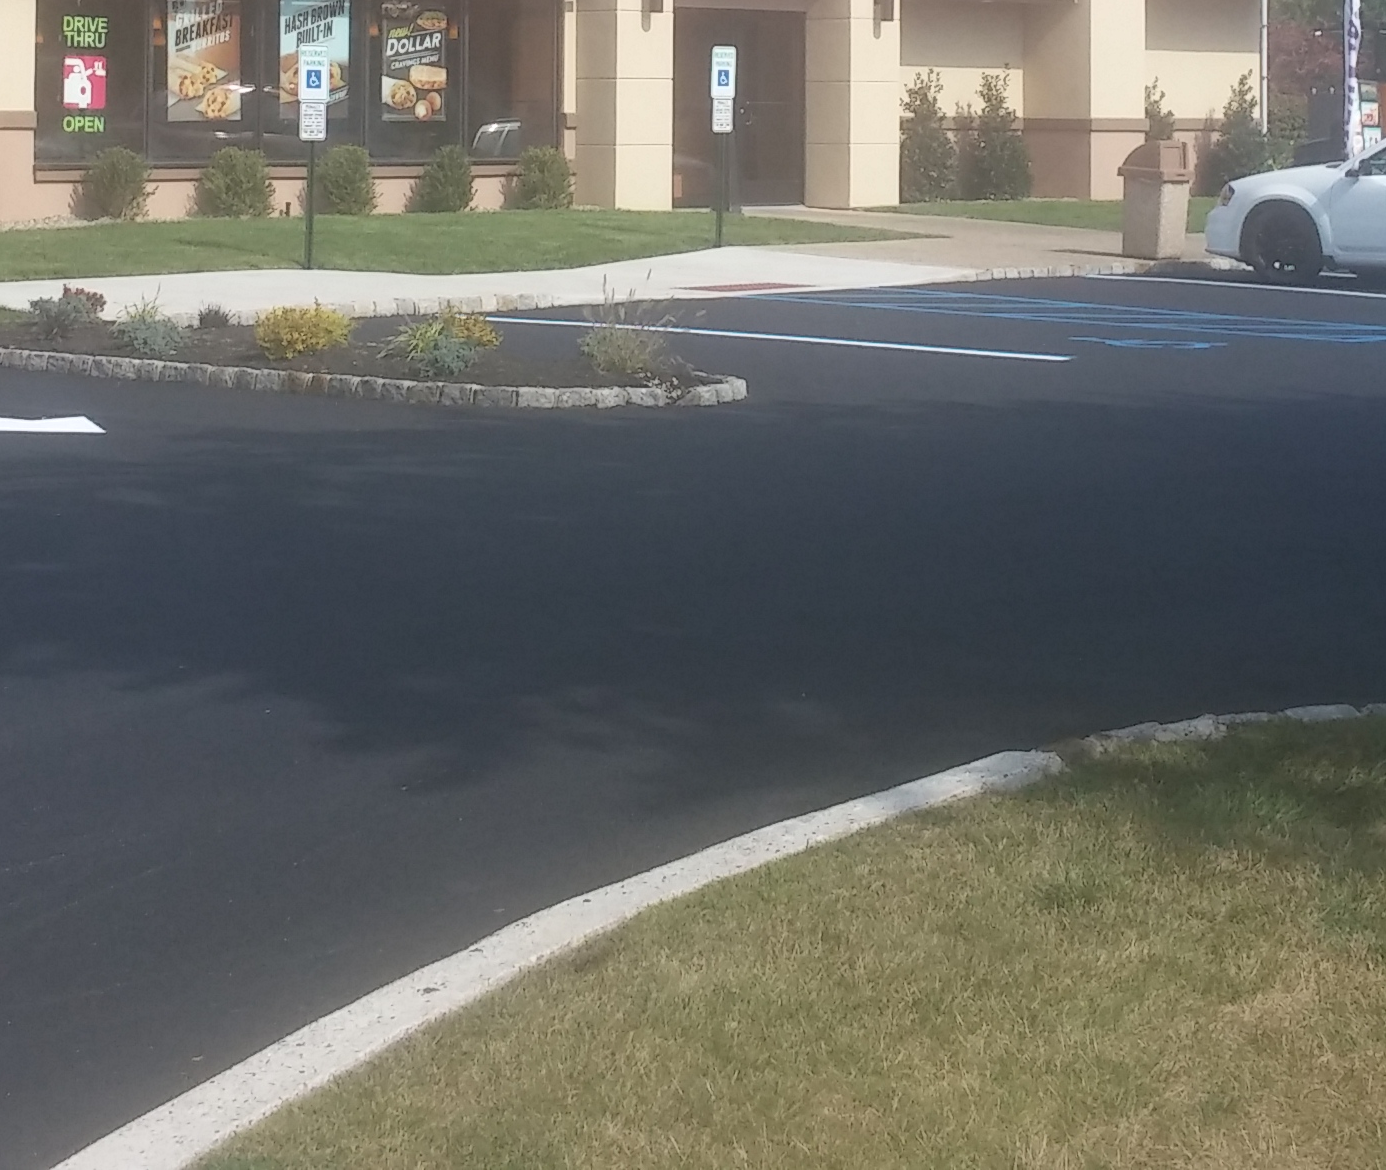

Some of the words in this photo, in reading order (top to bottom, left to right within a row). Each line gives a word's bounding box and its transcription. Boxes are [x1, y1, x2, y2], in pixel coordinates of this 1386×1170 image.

[63, 15, 109, 33] DRIVE
[174, 13, 234, 47] BREAKFAST
[284, 10, 309, 35] HASH
[295, 19, 334, 49] BUILT-IN
[63, 31, 107, 48] THRU
[386, 32, 442, 57] DOLLAR
[62, 115, 105, 133] OPEN
